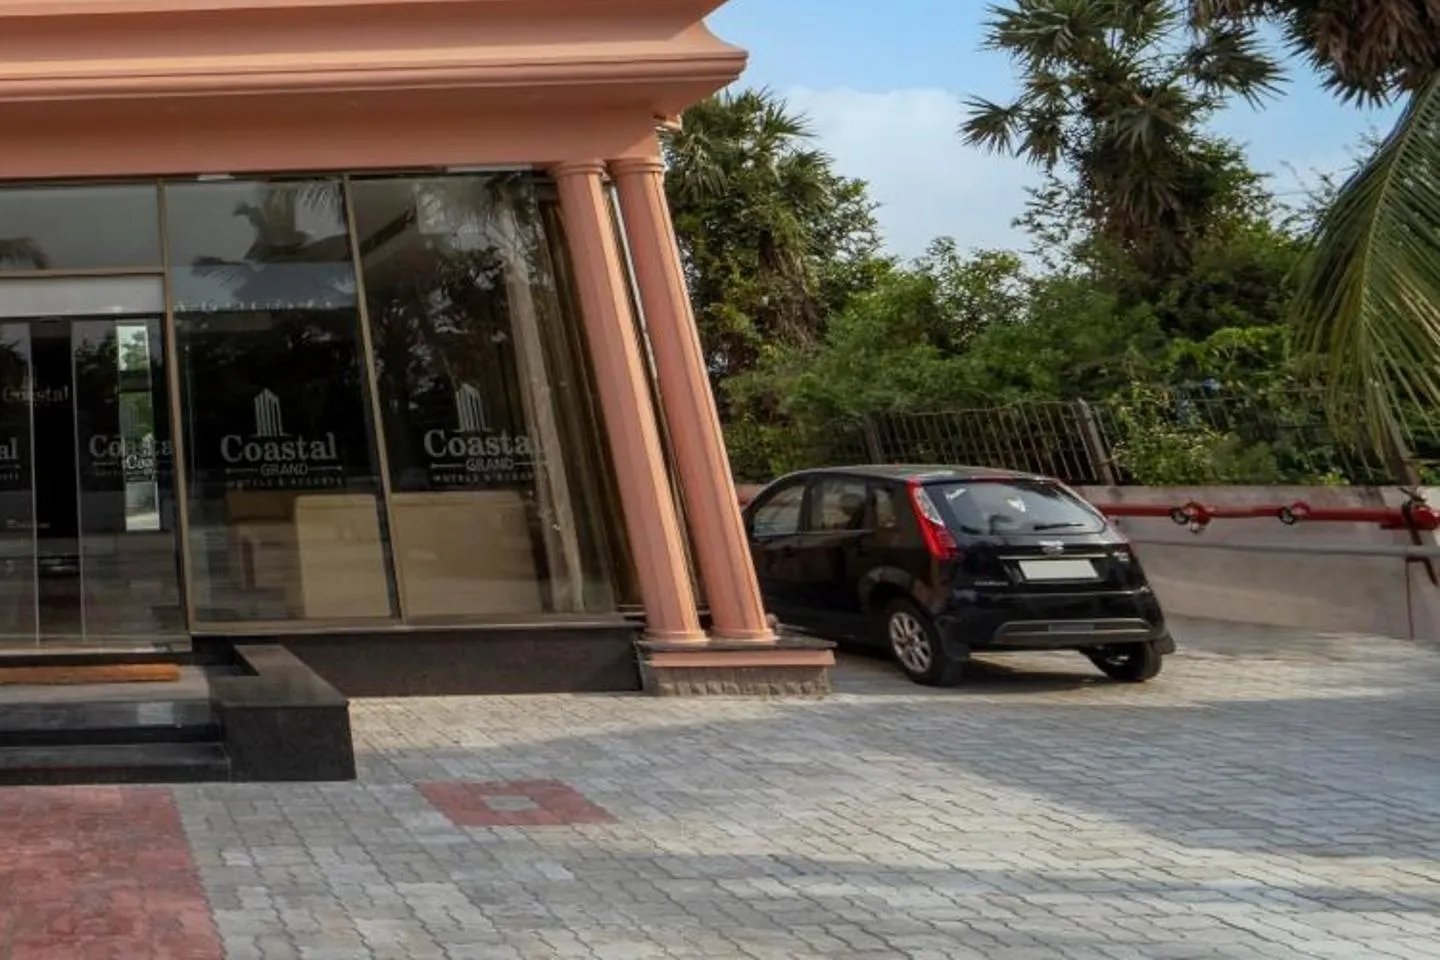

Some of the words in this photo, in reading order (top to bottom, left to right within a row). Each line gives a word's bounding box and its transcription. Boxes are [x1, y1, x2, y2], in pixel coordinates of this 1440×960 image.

[220, 432, 339, 463] Coastal
[423, 428, 540, 458] Coasta
[260, 463, 308, 477] GRAND
[465, 456, 515, 471] GRAND
